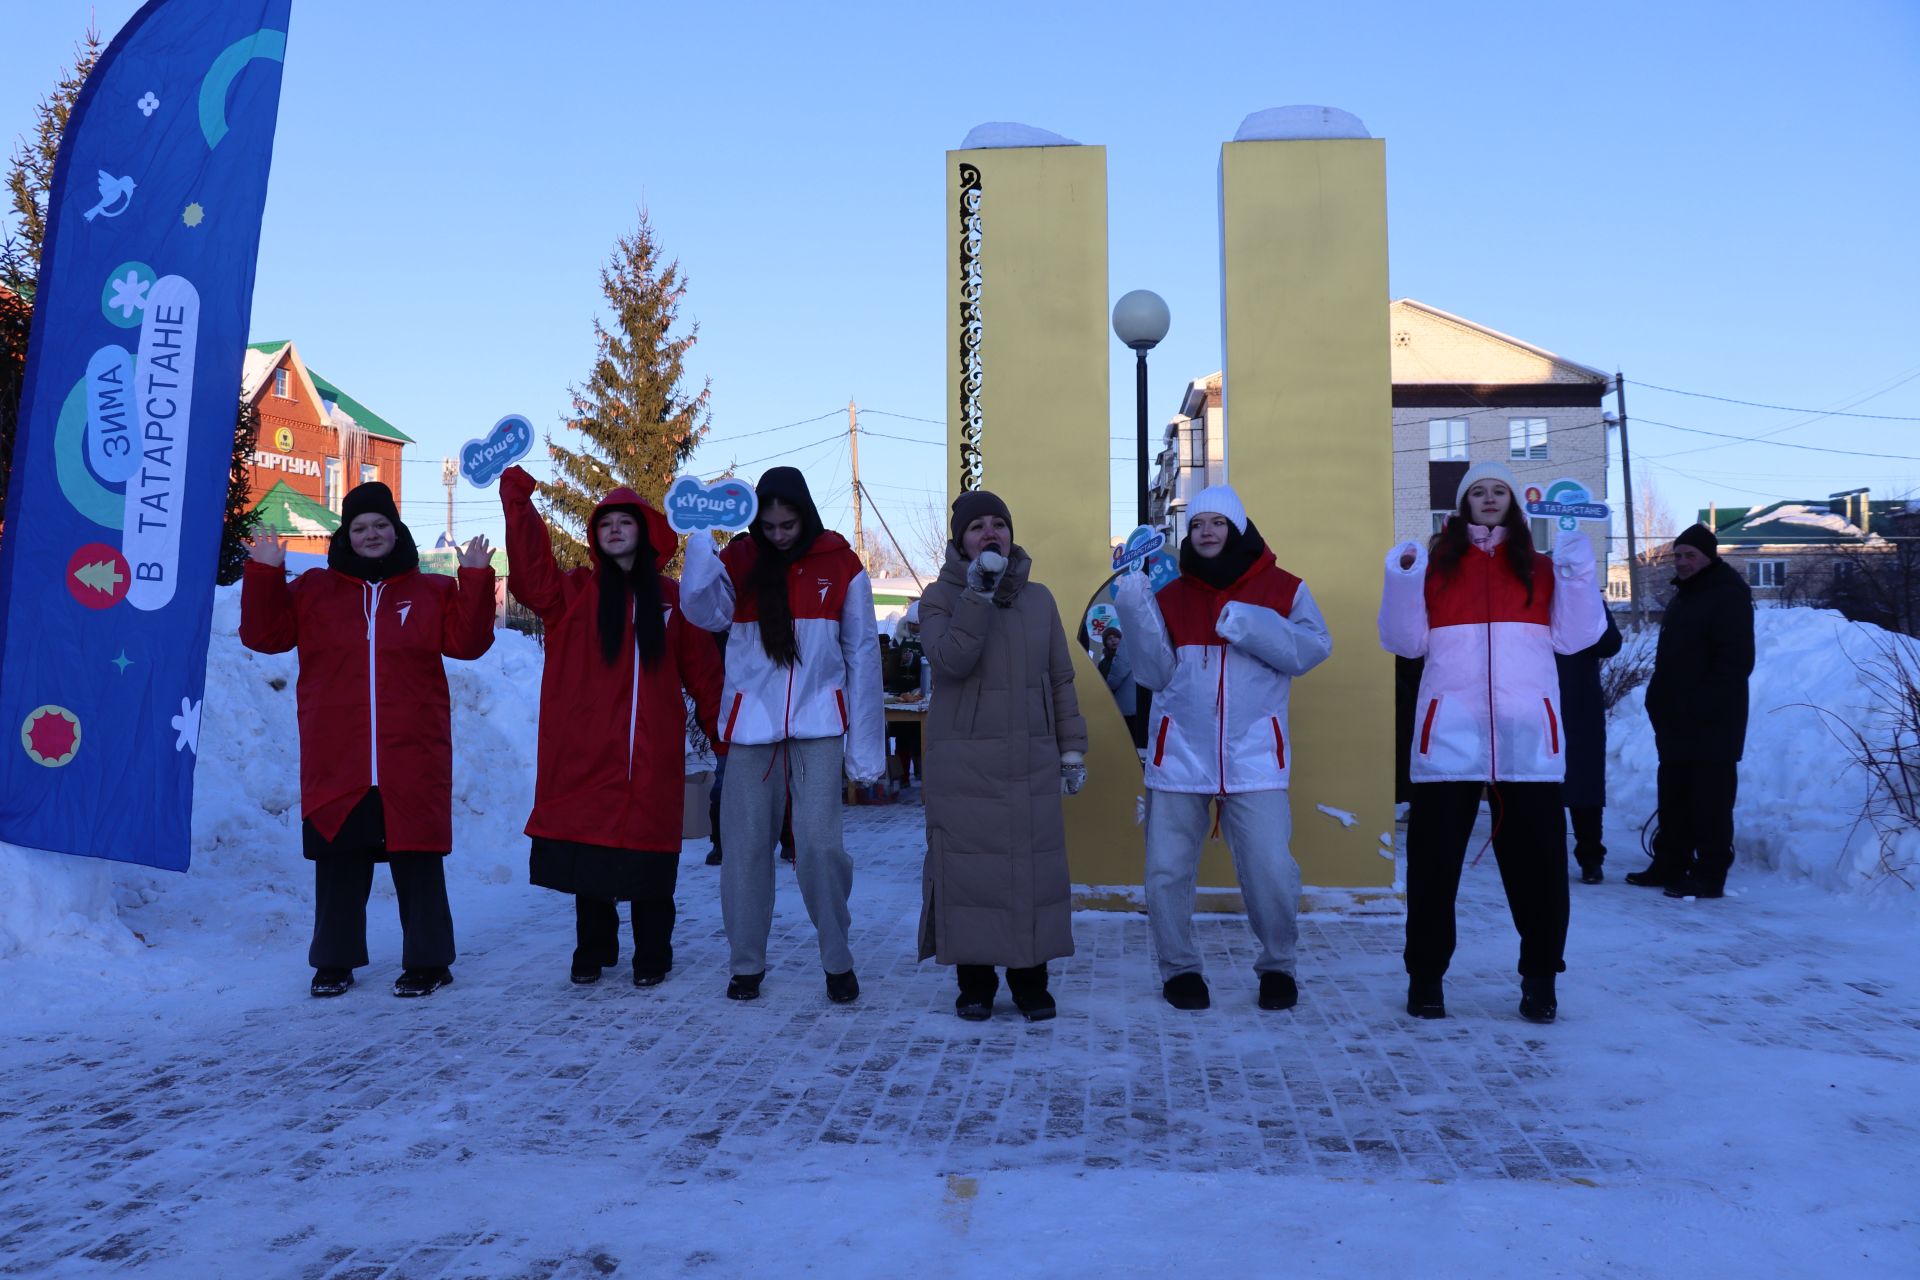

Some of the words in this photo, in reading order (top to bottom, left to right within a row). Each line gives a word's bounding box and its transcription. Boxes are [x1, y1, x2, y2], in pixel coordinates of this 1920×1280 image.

[97, 363, 130, 458] ЗИМА
[138, 305, 184, 534] ТАТАРСТАНЕ
[1532, 503, 1539, 512] В
[1544, 504, 1603, 516] ТАТАРСТАНЕ
[136, 561, 163, 583] В
